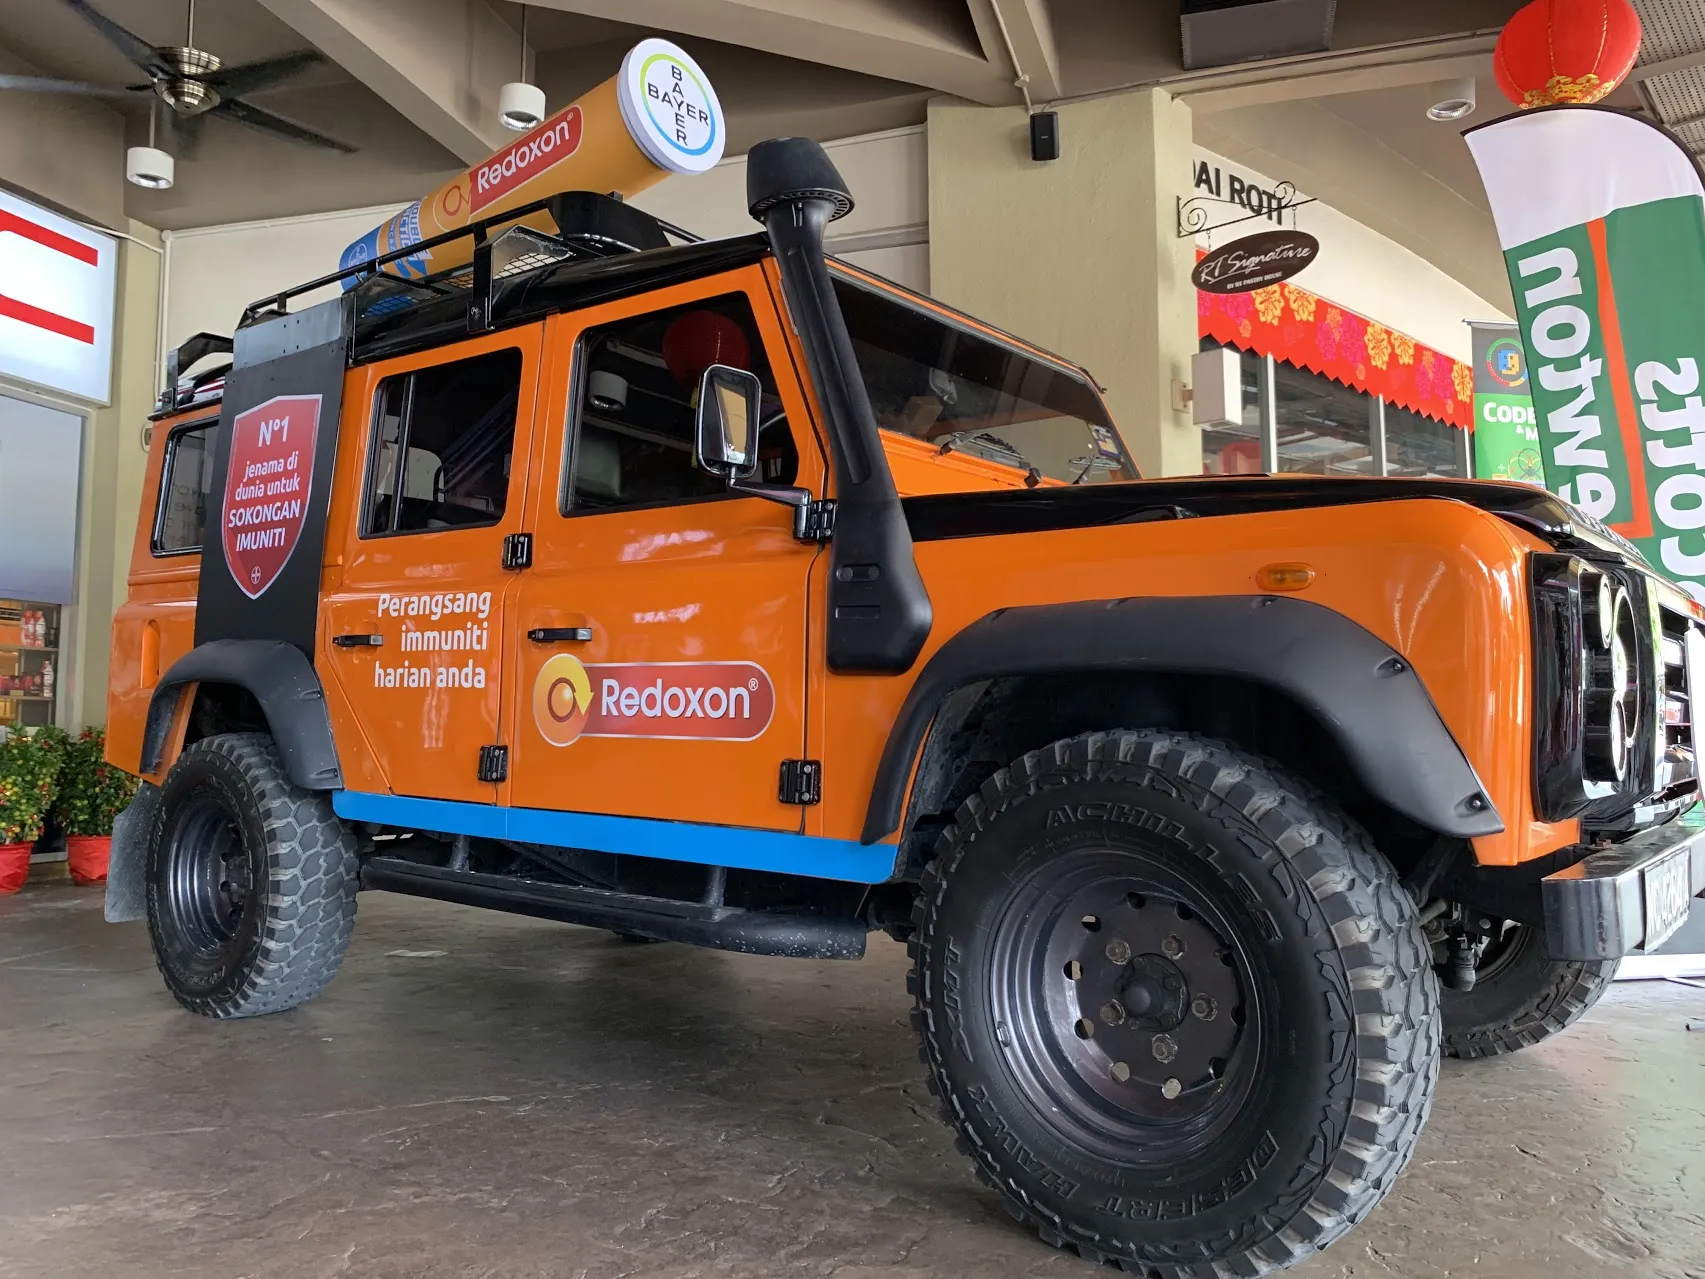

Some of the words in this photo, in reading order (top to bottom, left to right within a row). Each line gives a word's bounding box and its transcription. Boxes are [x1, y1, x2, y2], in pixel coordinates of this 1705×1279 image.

[648, 82, 709, 127] BAYER
[671, 65, 688, 146] BAYER
[1193, 159, 1221, 197] AI
[1228, 174, 1283, 226] ROTI
[1227, 243, 1312, 275] Signature
[243, 458, 283, 483] jenama
[287, 450, 299, 470] di
[235, 481, 264, 501] dunia
[267, 476, 300, 496] untuk
[228, 499, 301, 528] SOKONGAN
[236, 527, 286, 552] IMUNITI
[377, 590, 492, 621] Perangsang
[400, 621, 488, 652] immuniti
[374, 661, 431, 689] harian
[436, 659, 486, 689] anda
[1045, 800, 1286, 943] ACHILLES
[1096, 1128, 1280, 1223] DESERT
